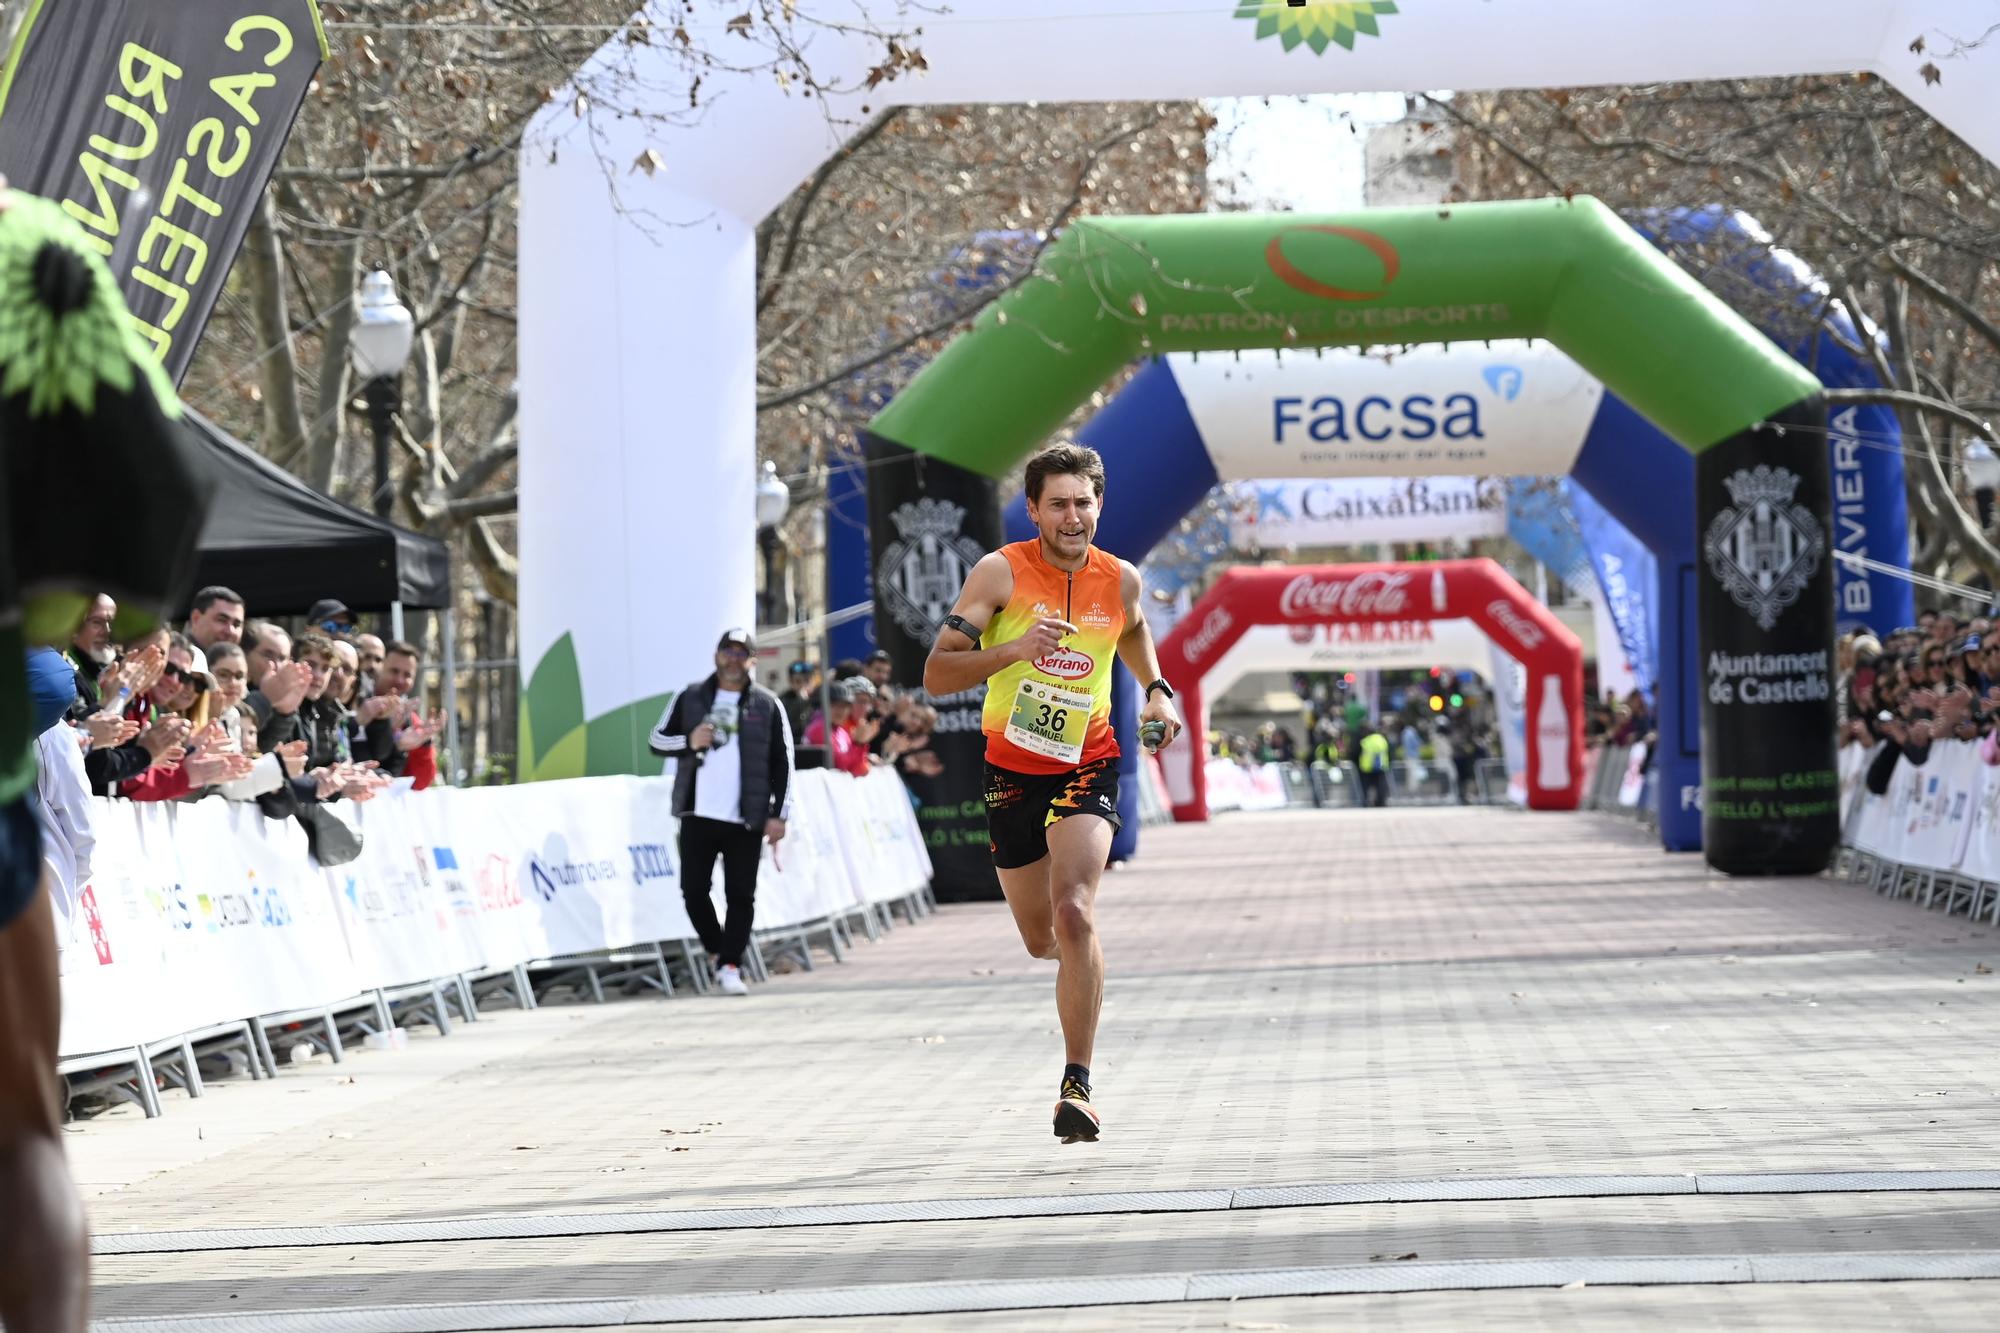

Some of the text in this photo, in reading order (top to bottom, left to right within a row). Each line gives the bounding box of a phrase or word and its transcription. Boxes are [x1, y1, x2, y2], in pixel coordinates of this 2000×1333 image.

[1302, 478, 1503, 521] CaixaBank
[1832, 404, 1872, 614] BAVIERA
[1081, 615, 1112, 624] SERRANO
[1037, 655, 1090, 672] Serrano
[1707, 648, 1828, 679] Ajuntament
[1708, 672, 1830, 704] de Castelló
[1027, 722, 1065, 743] SAMUEL
[1035, 704, 1068, 732] 36
